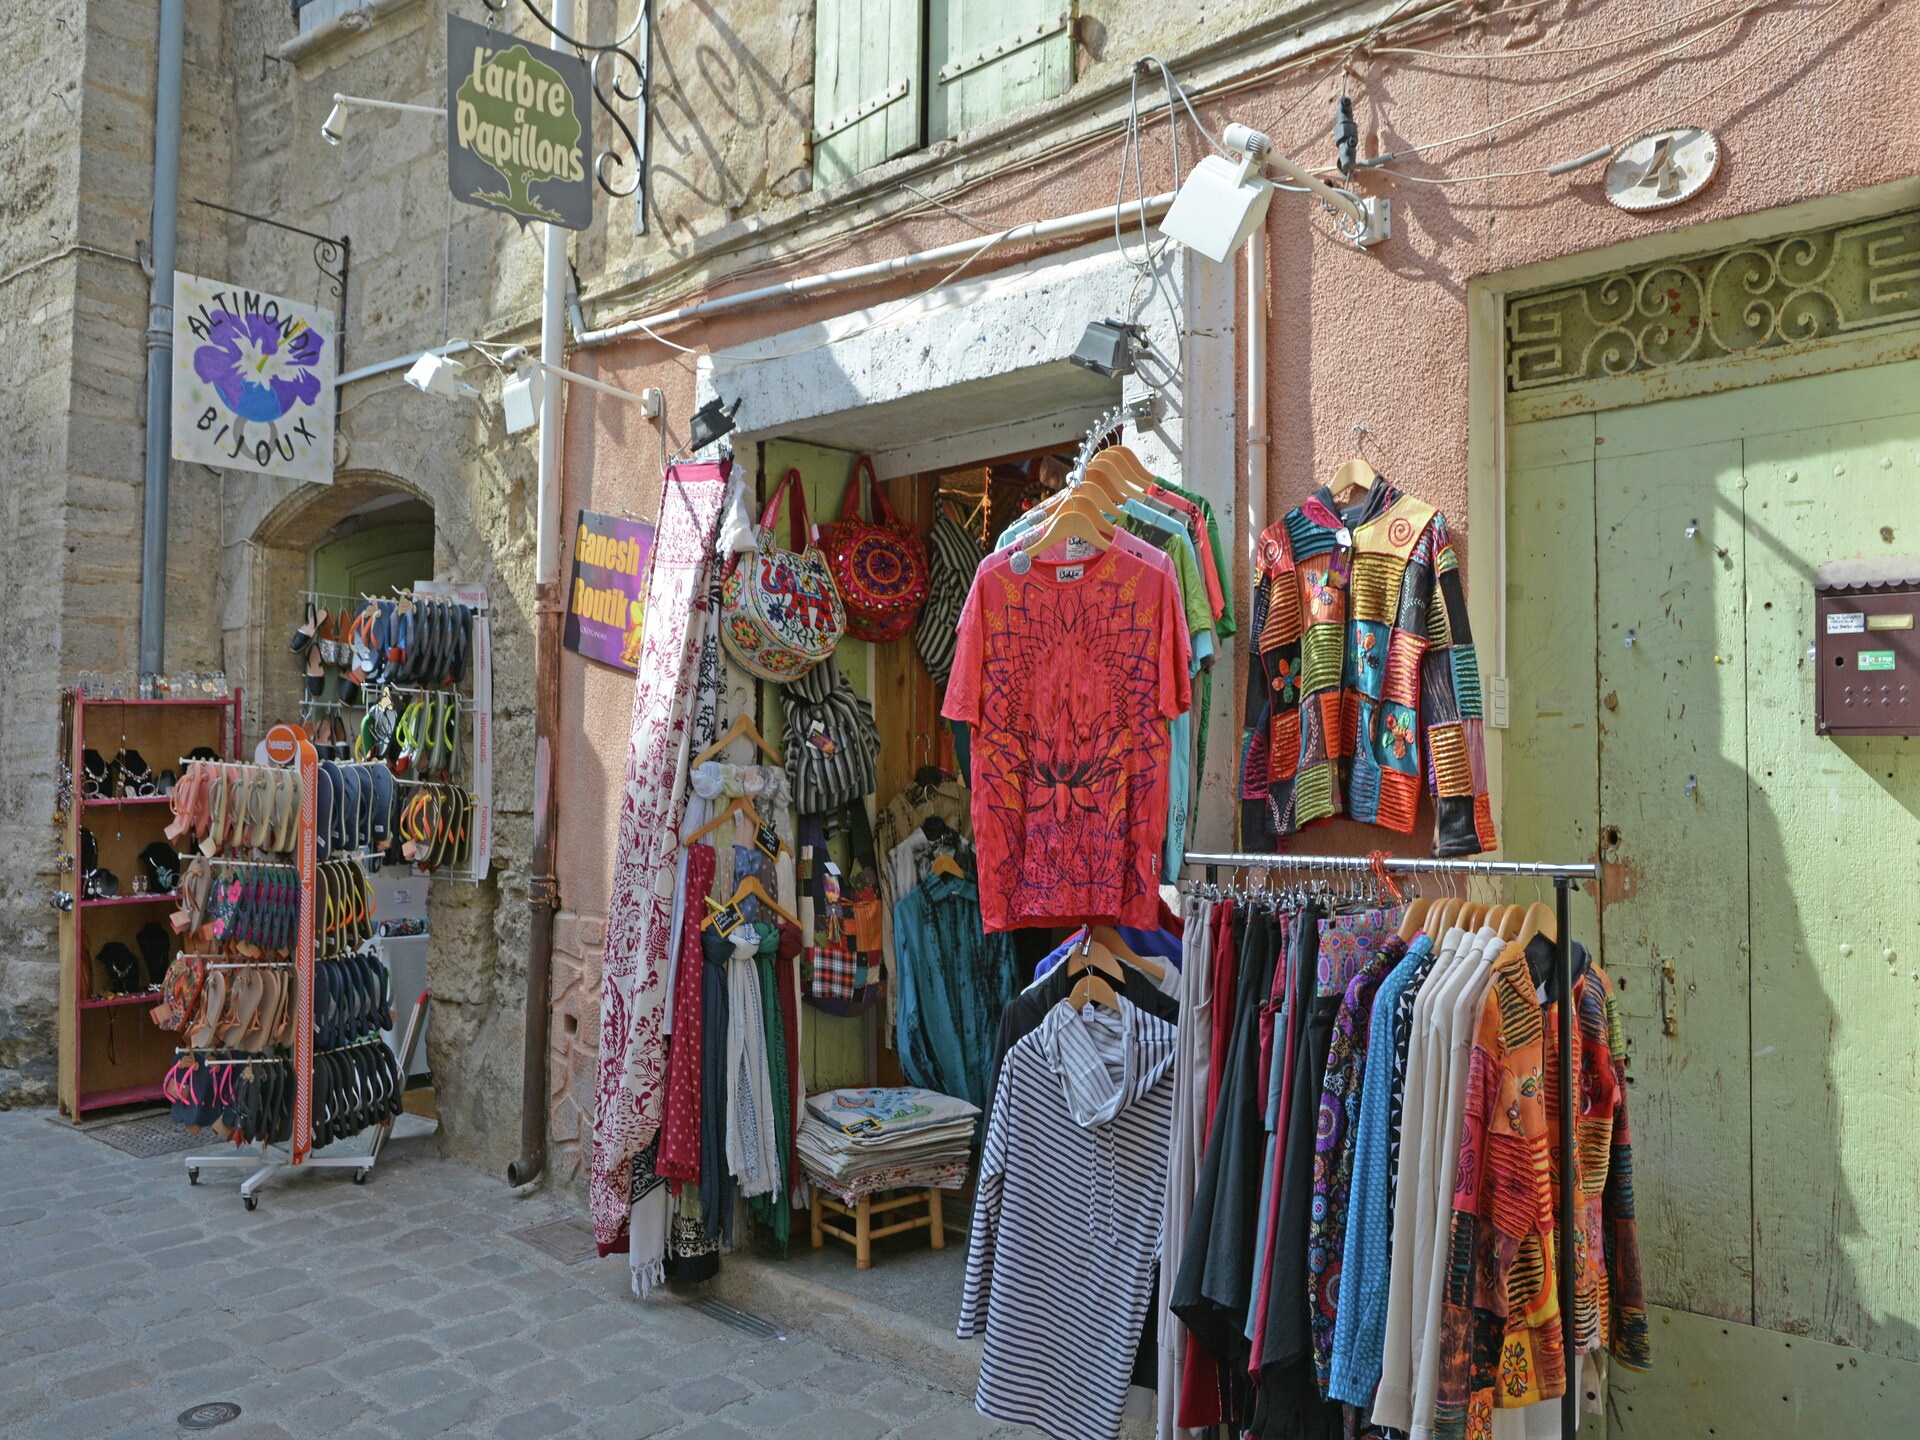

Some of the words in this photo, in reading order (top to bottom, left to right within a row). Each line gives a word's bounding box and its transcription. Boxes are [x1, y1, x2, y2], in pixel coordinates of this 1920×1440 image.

[457, 99, 585, 182] Papillons
[1637, 136, 1682, 197] 4
[187, 290, 317, 360] ALTIMONDI
[196, 406, 317, 467] BIJOUX
[575, 523, 640, 577] Ganesh
[571, 577, 629, 630] Boutik
[302, 828, 313, 884] havaianas
